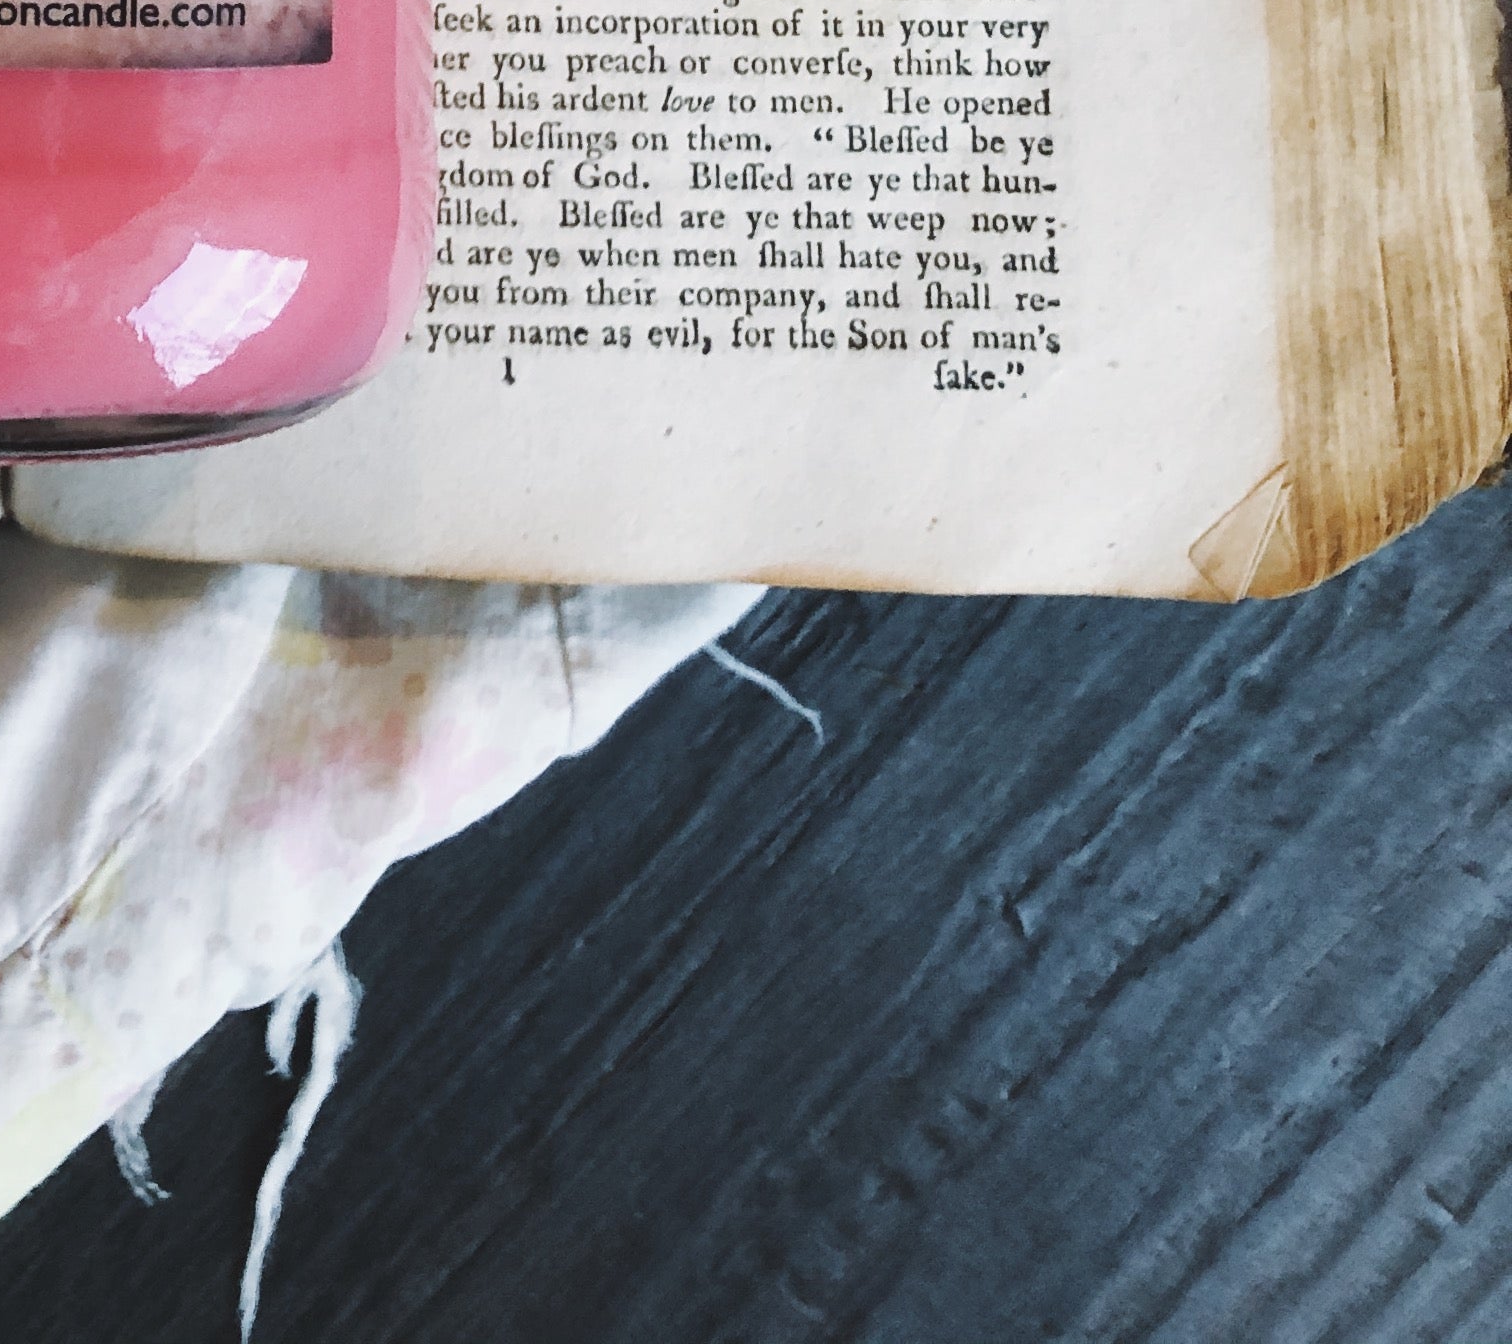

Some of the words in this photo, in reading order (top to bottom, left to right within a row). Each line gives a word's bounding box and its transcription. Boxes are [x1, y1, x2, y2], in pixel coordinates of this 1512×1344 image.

[506, 14, 542, 34] an
[555, 5, 760, 45] incorporation
[771, 7, 804, 37] of
[821, 8, 844, 39] it
[856, 9, 885, 38] in
[899, 19, 969, 48] your
[980, 20, 1050, 50] very
[425, 283, 480, 314] you
[496, 275, 569, 307] from
[585, 276, 657, 307] their
[678, 286, 827, 321] company,
[845, 281, 901, 309] and
[426, 323, 496, 354] your
[508, 324, 590, 348] name
[601, 325, 632, 350] as
[647, 316, 713, 356] evil,
[731, 316, 776, 350] for
[788, 315, 836, 351] the
[847, 318, 908, 352] Son
[920, 319, 954, 350] of
